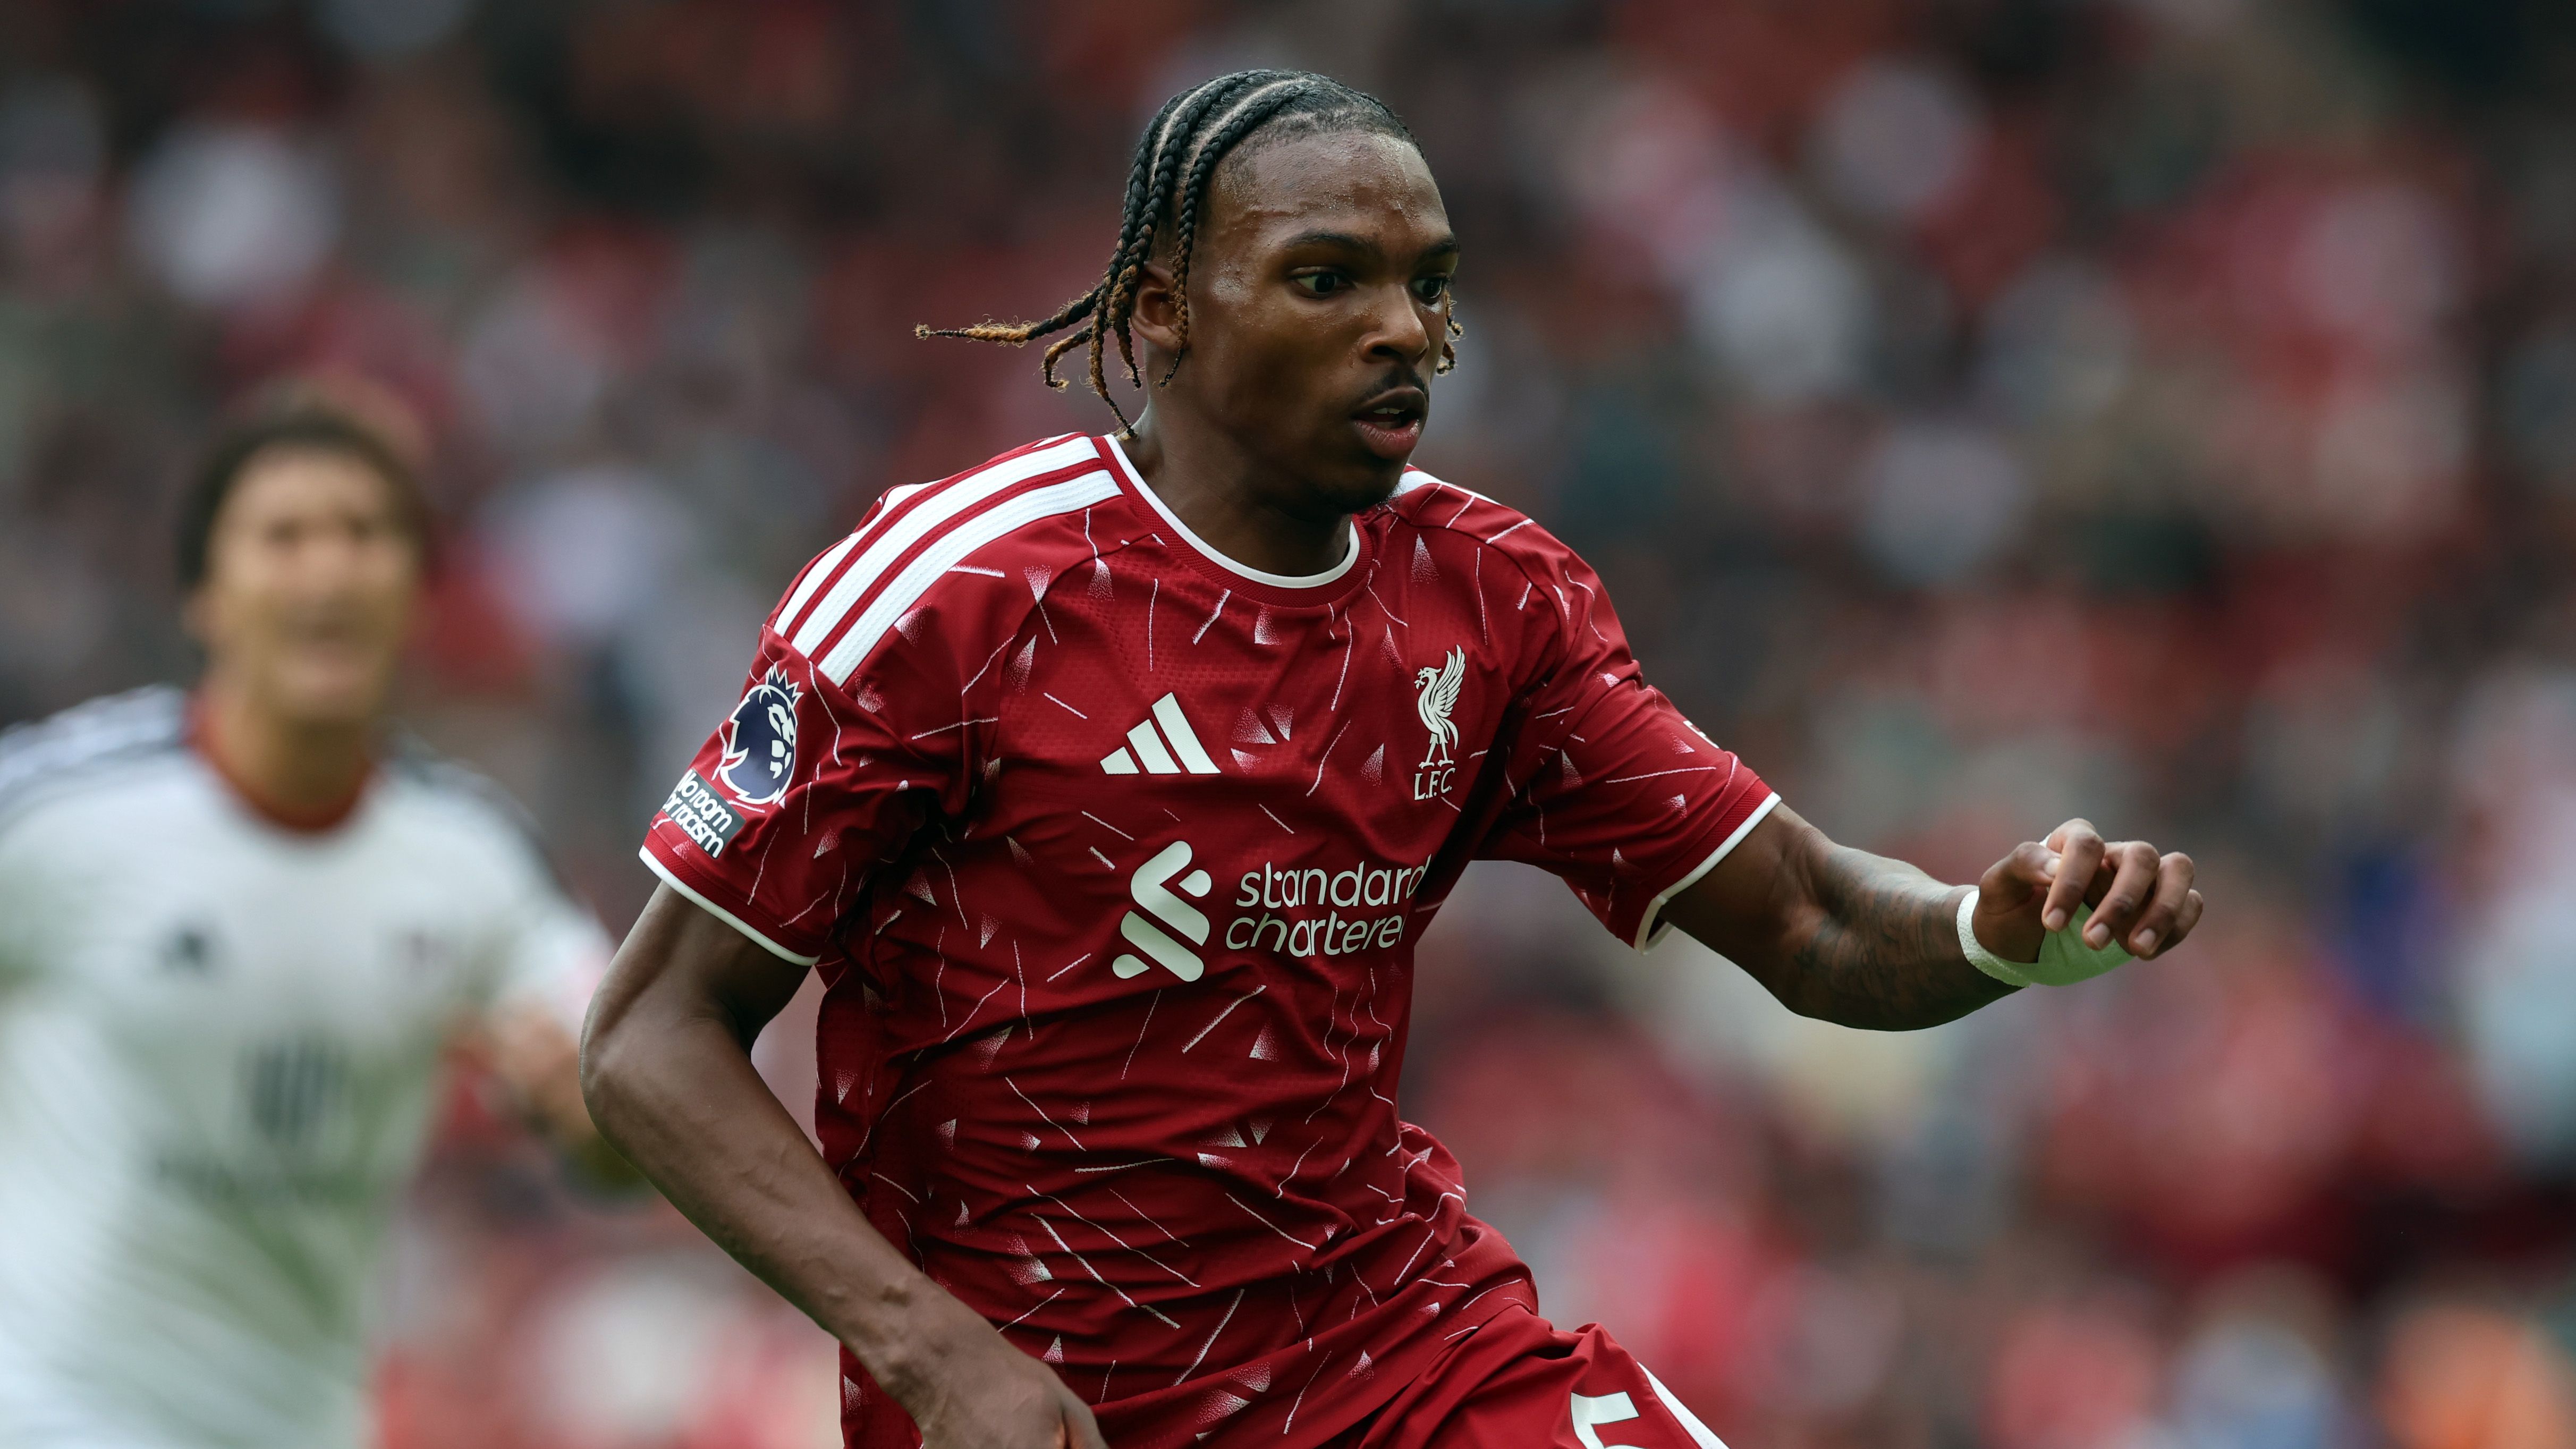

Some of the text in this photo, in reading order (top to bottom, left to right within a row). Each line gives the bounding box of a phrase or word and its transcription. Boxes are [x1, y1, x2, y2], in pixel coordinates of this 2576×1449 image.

[671, 803, 724, 858] racism
[689, 789, 733, 833] room
[1235, 854, 1431, 909] standard
